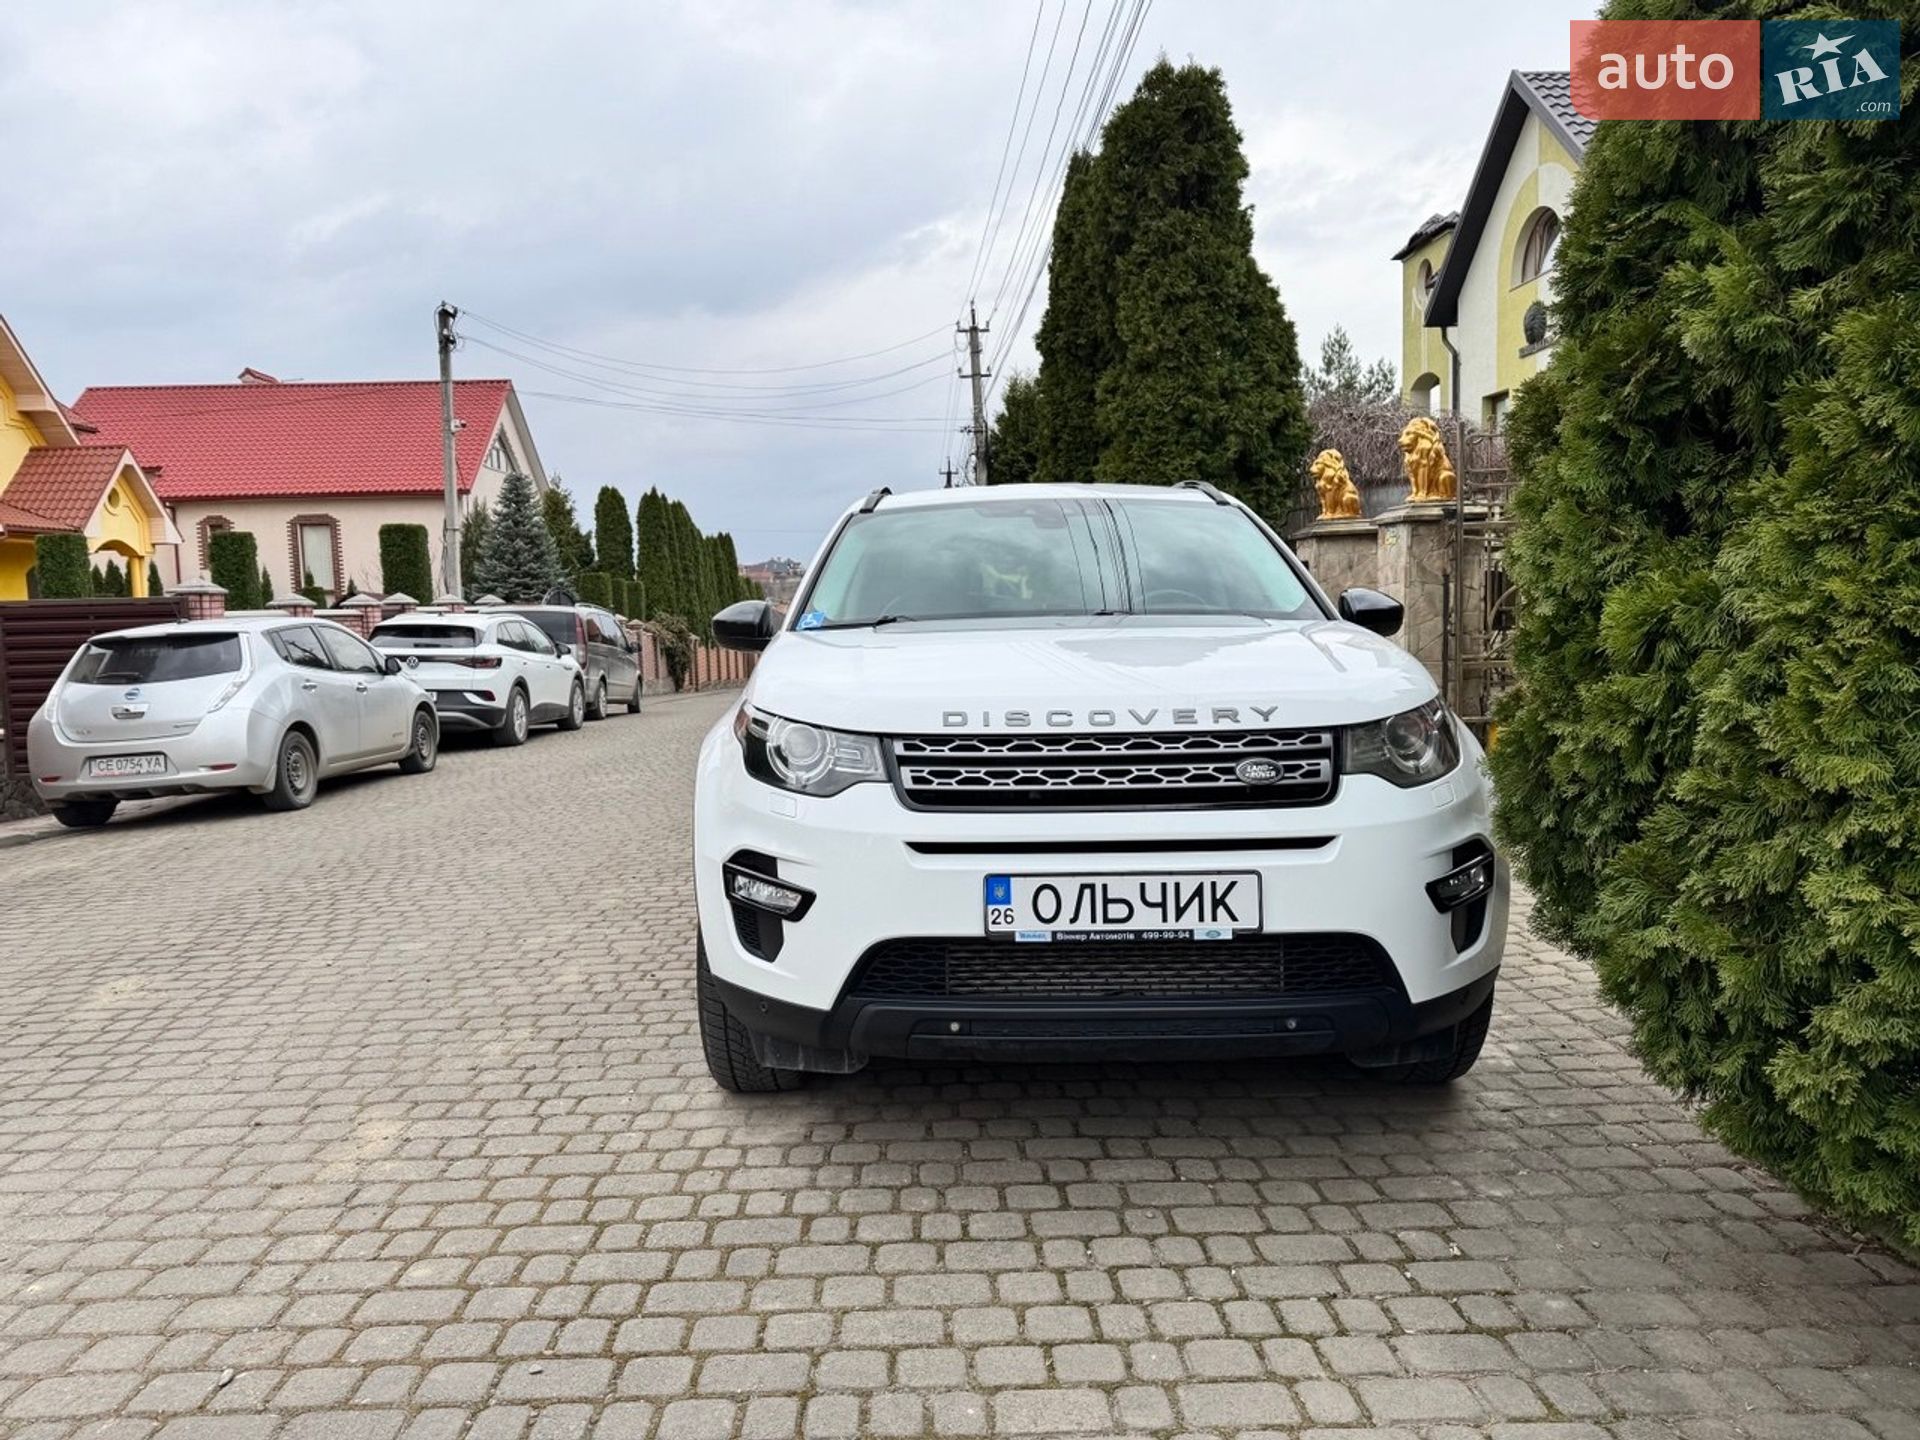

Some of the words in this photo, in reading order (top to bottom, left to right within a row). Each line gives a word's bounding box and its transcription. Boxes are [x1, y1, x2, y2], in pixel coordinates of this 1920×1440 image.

[942, 705, 1279, 728] DISCOVERY
[990, 907, 1015, 925] 26
[1031, 880, 1240, 925] ОЛЬЧИК
